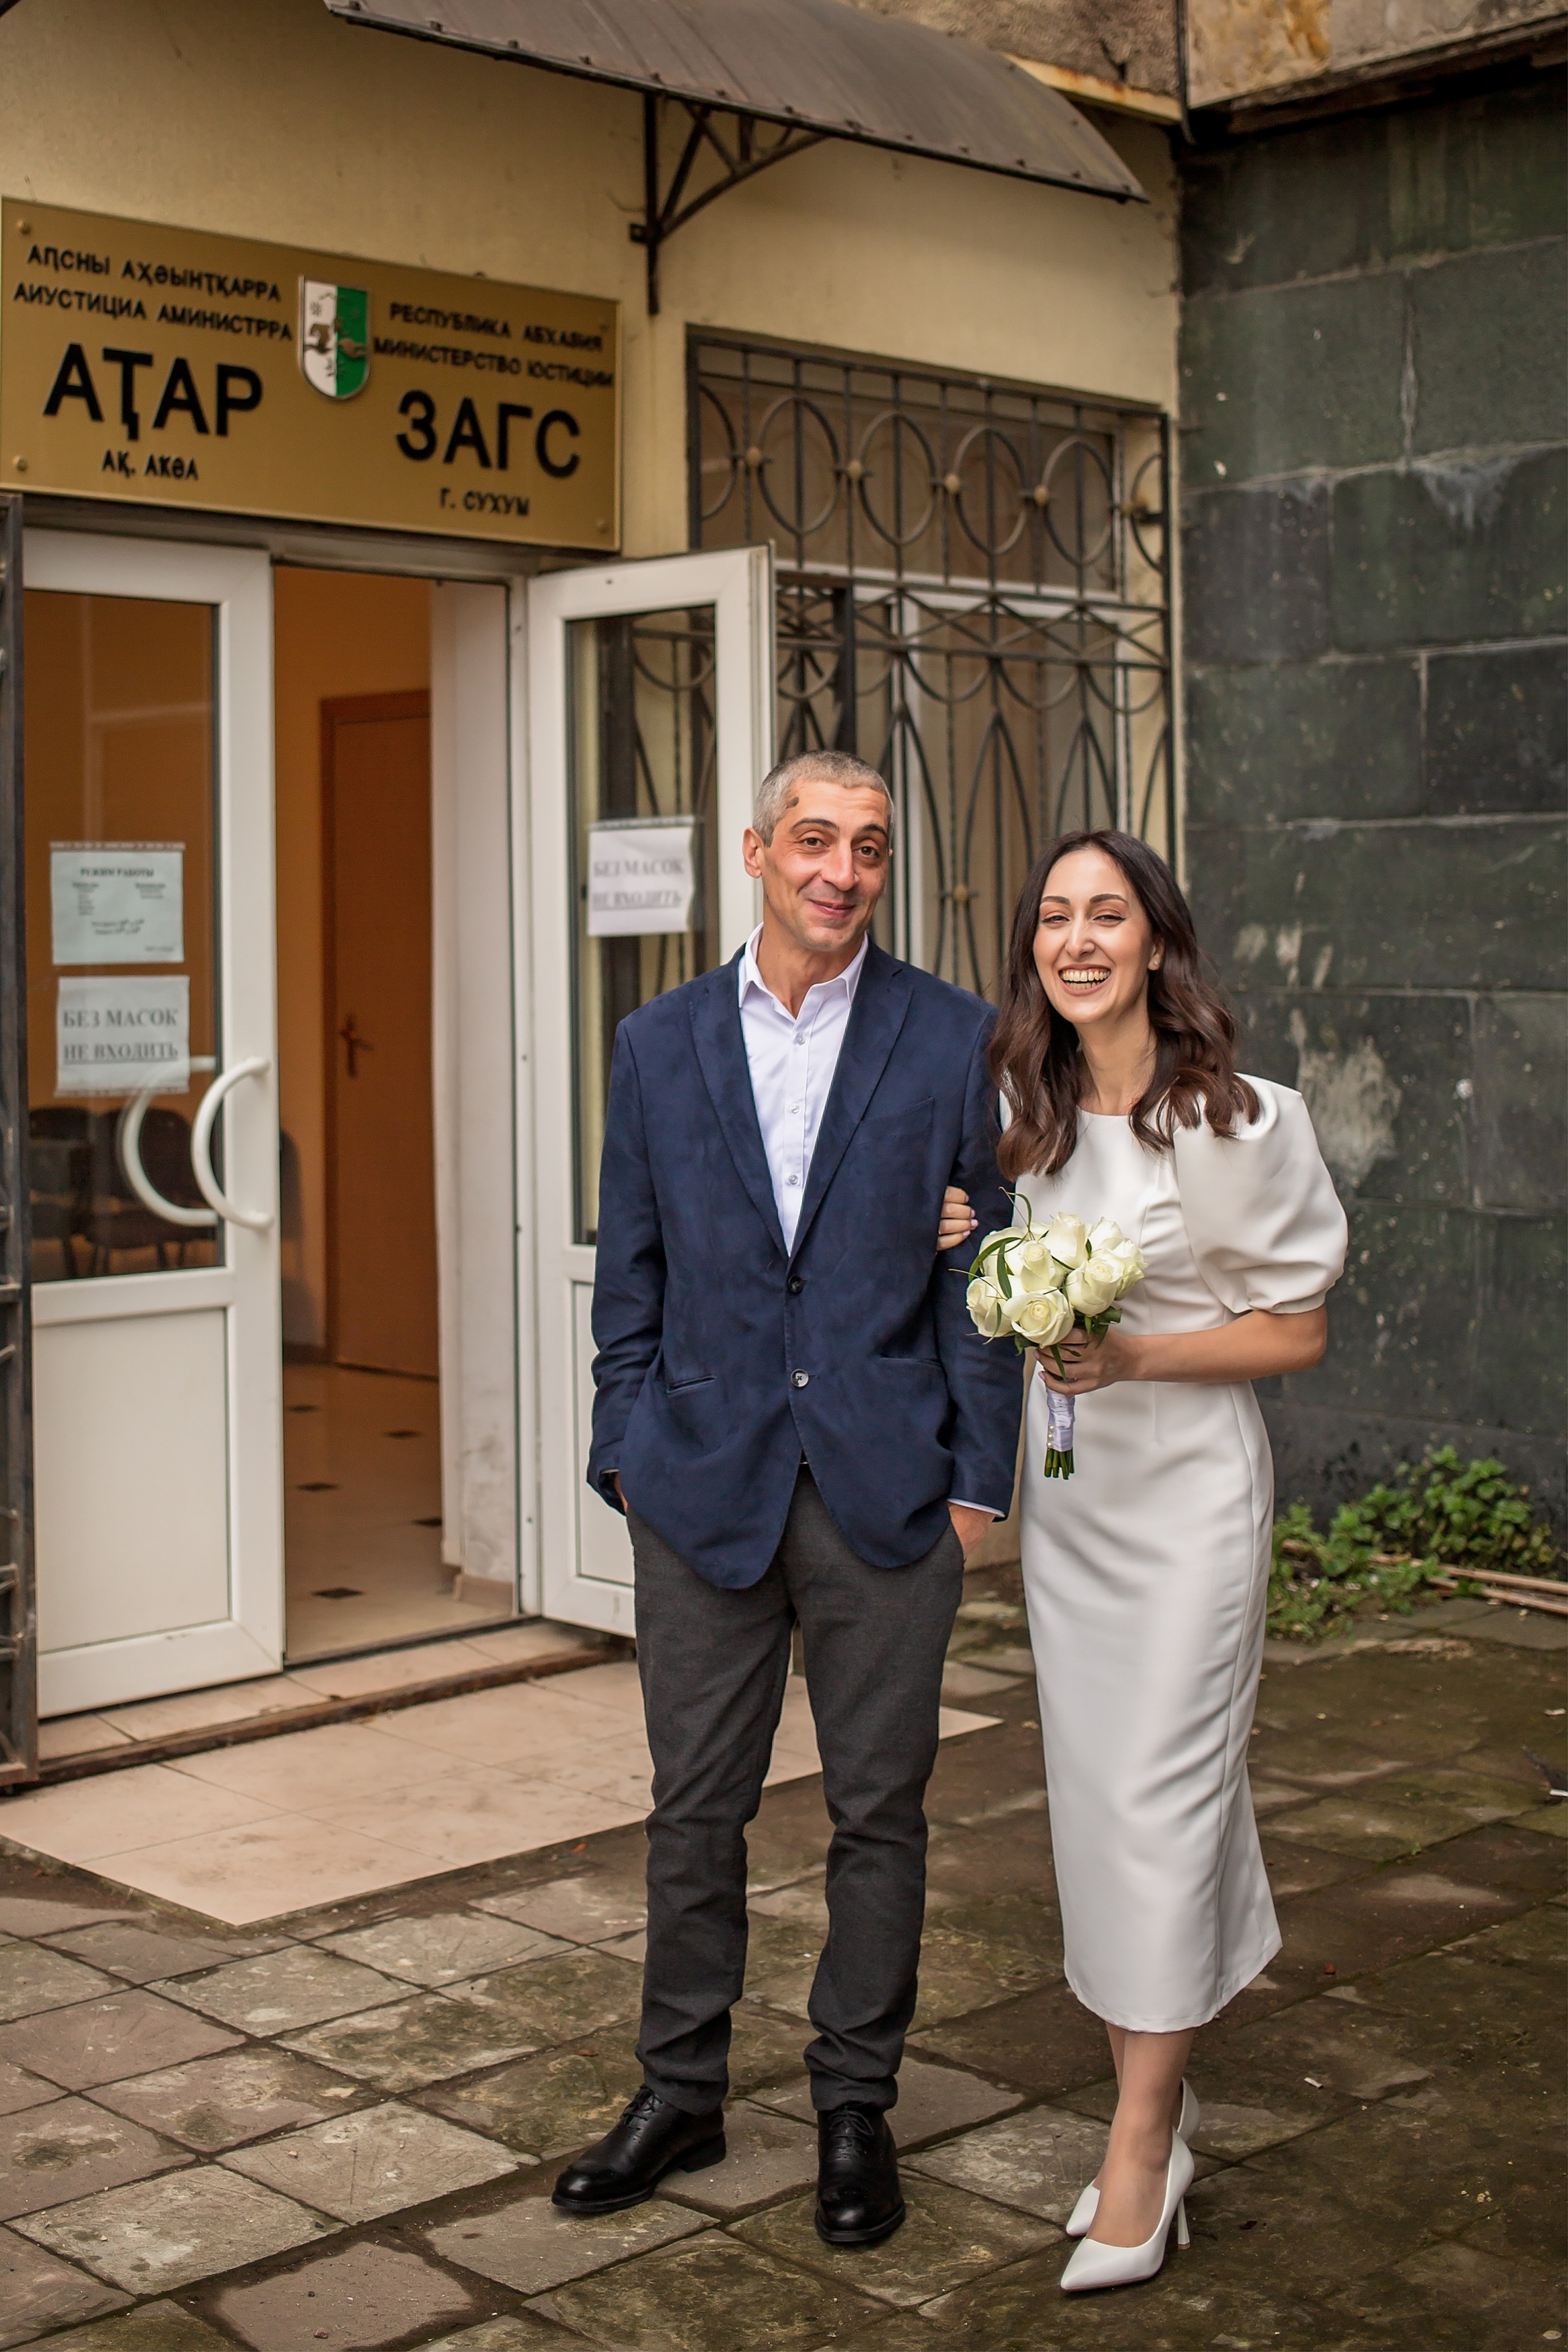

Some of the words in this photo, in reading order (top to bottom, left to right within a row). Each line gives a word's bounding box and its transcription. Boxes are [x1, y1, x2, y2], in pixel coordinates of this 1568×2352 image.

[13, 281, 146, 320] АИУСТИЦИА
[157, 303, 292, 340] АМИНИСТРРА
[390, 301, 511, 338] РЕСПУБЛИКА
[374, 336, 521, 375] МИНИСТЕРСТВО
[527, 359, 613, 388] ЮСТИЦИИ
[396, 390, 580, 478] ЗАГС
[463, 491, 530, 516] СУХУМ
[63, 1009, 100, 1029] БЕЗ
[105, 1008, 178, 1028] МАСОК
[64, 1043, 89, 1061] НЕ
[94, 1042, 178, 1061] ВХОДИТЬ
